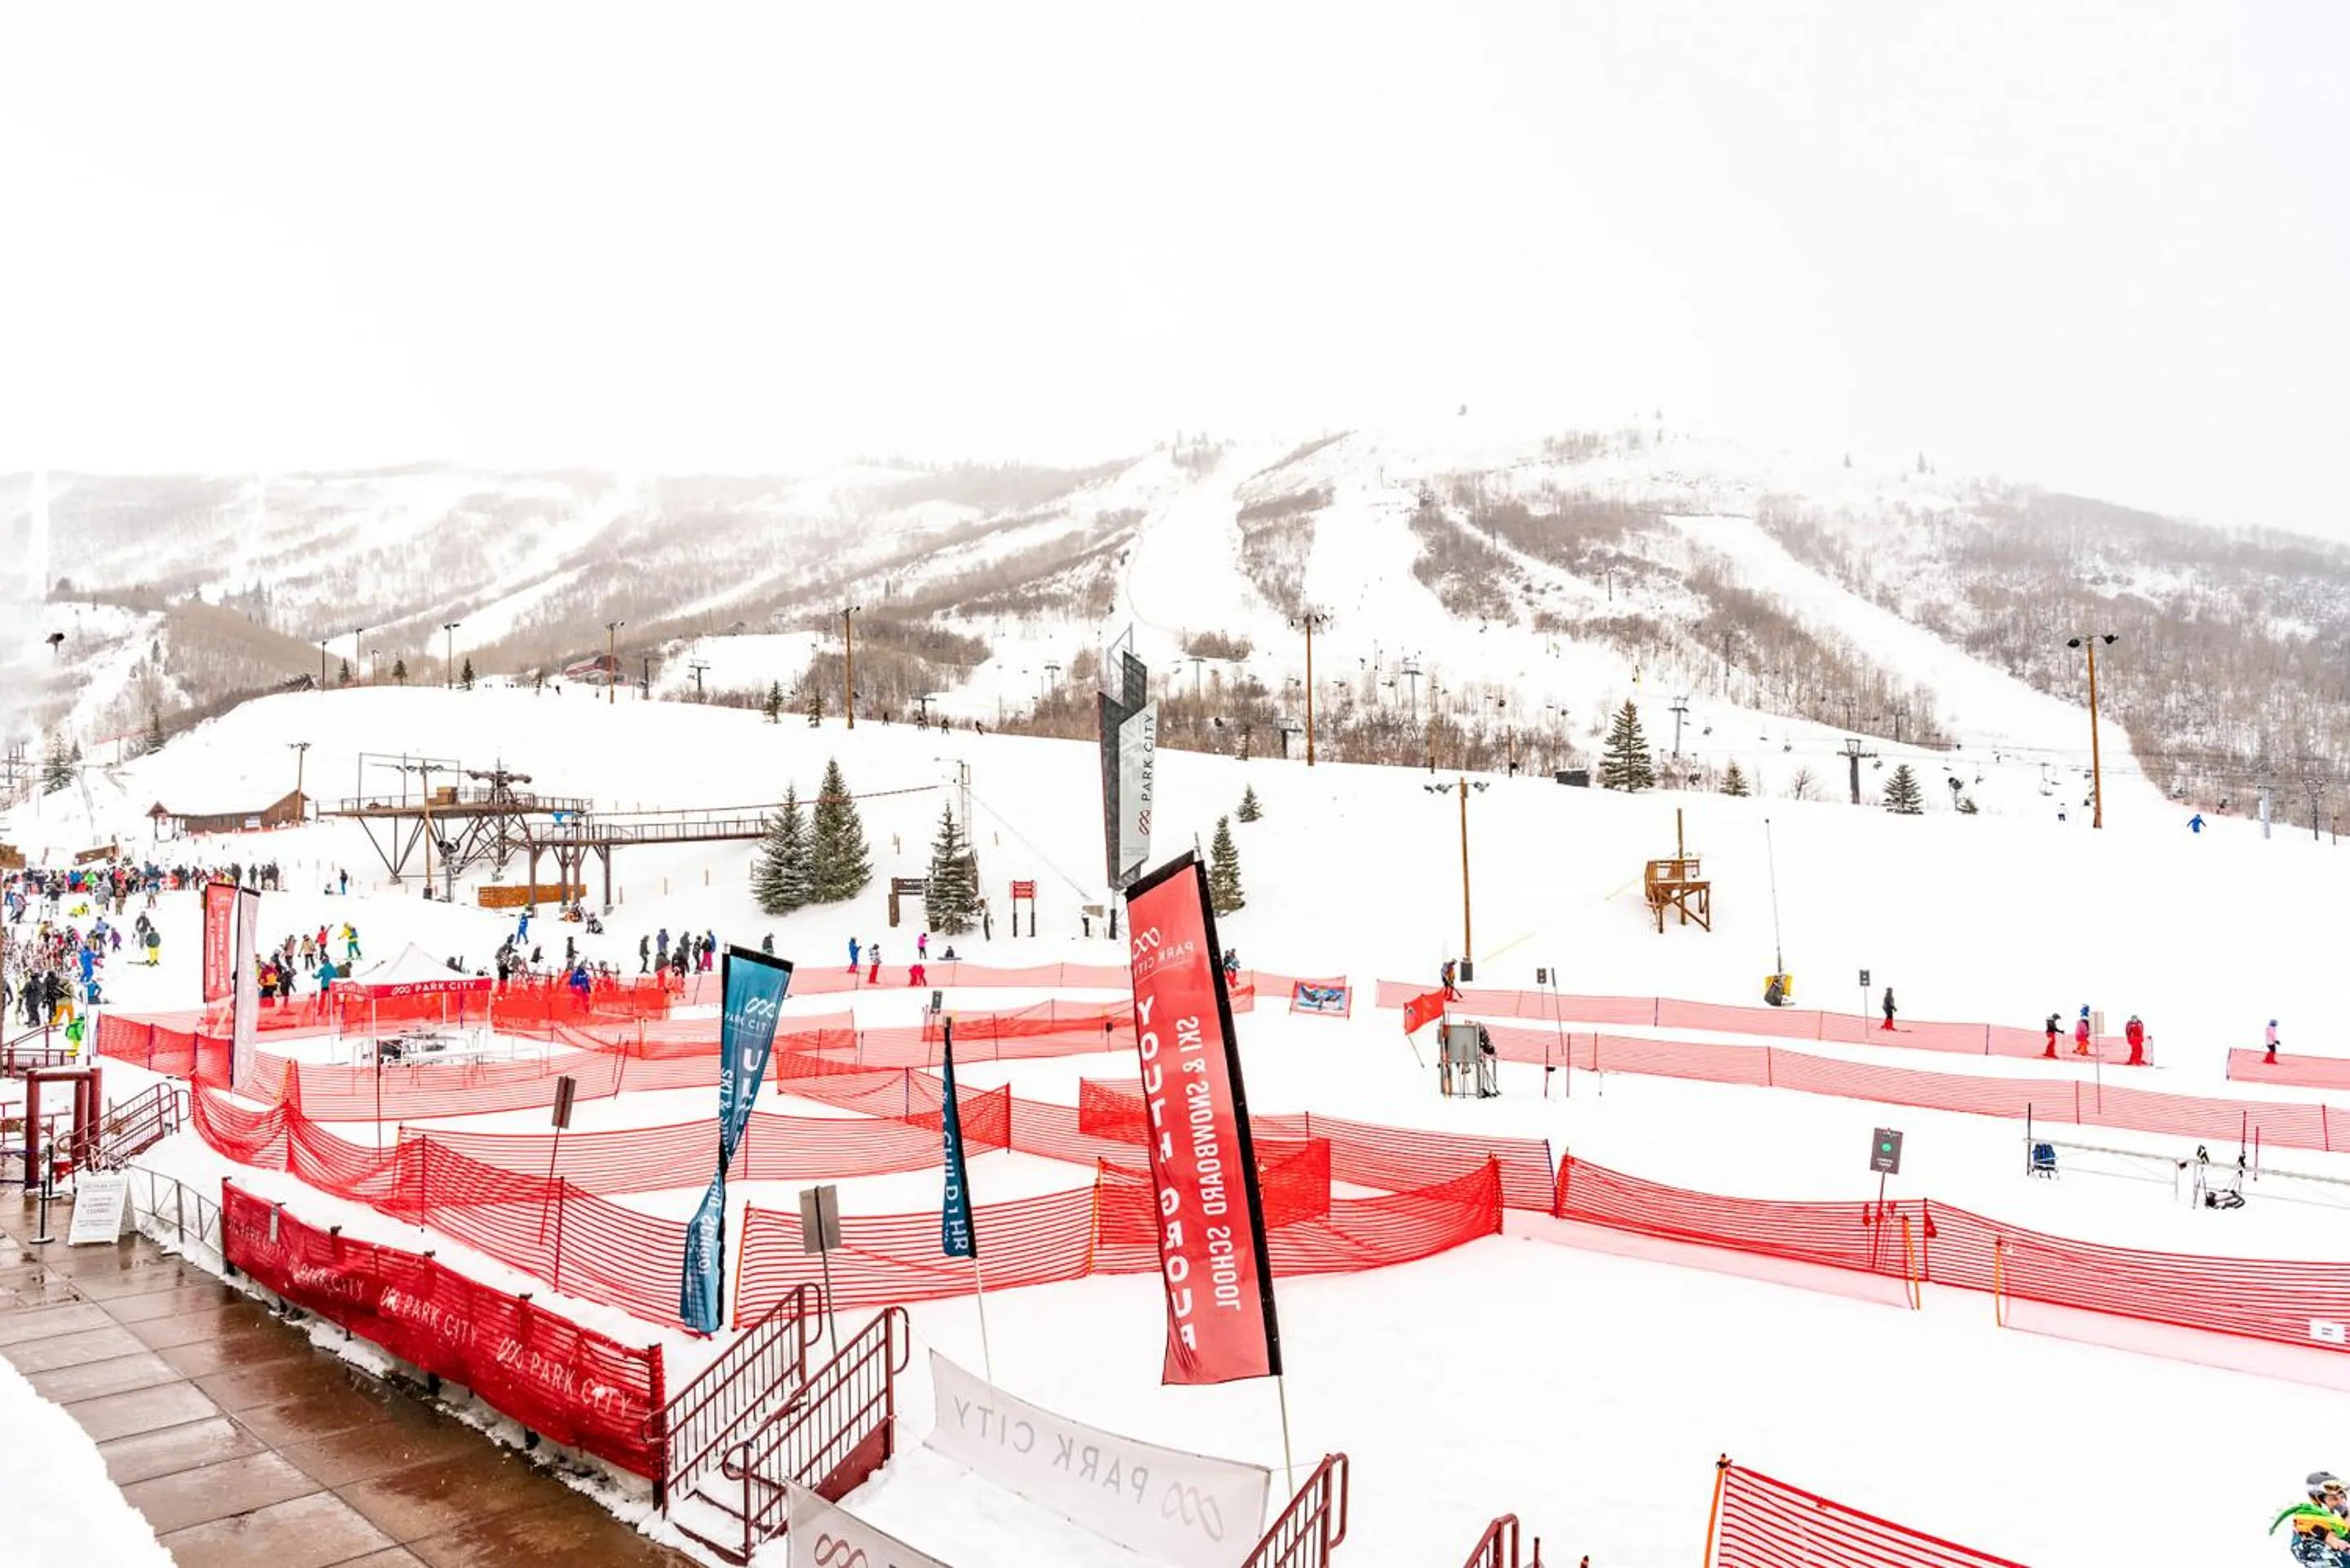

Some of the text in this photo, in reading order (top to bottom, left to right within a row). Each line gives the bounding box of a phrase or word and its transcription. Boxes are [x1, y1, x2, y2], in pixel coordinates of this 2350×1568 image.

[1141, 713, 1154, 802] PARK CITY
[415, 981, 476, 993] PARK CITY
[748, 1019, 772, 1032] CIT
[403, 1295, 478, 1347] PARK CITY
[530, 1355, 633, 1419] PARK CITY
